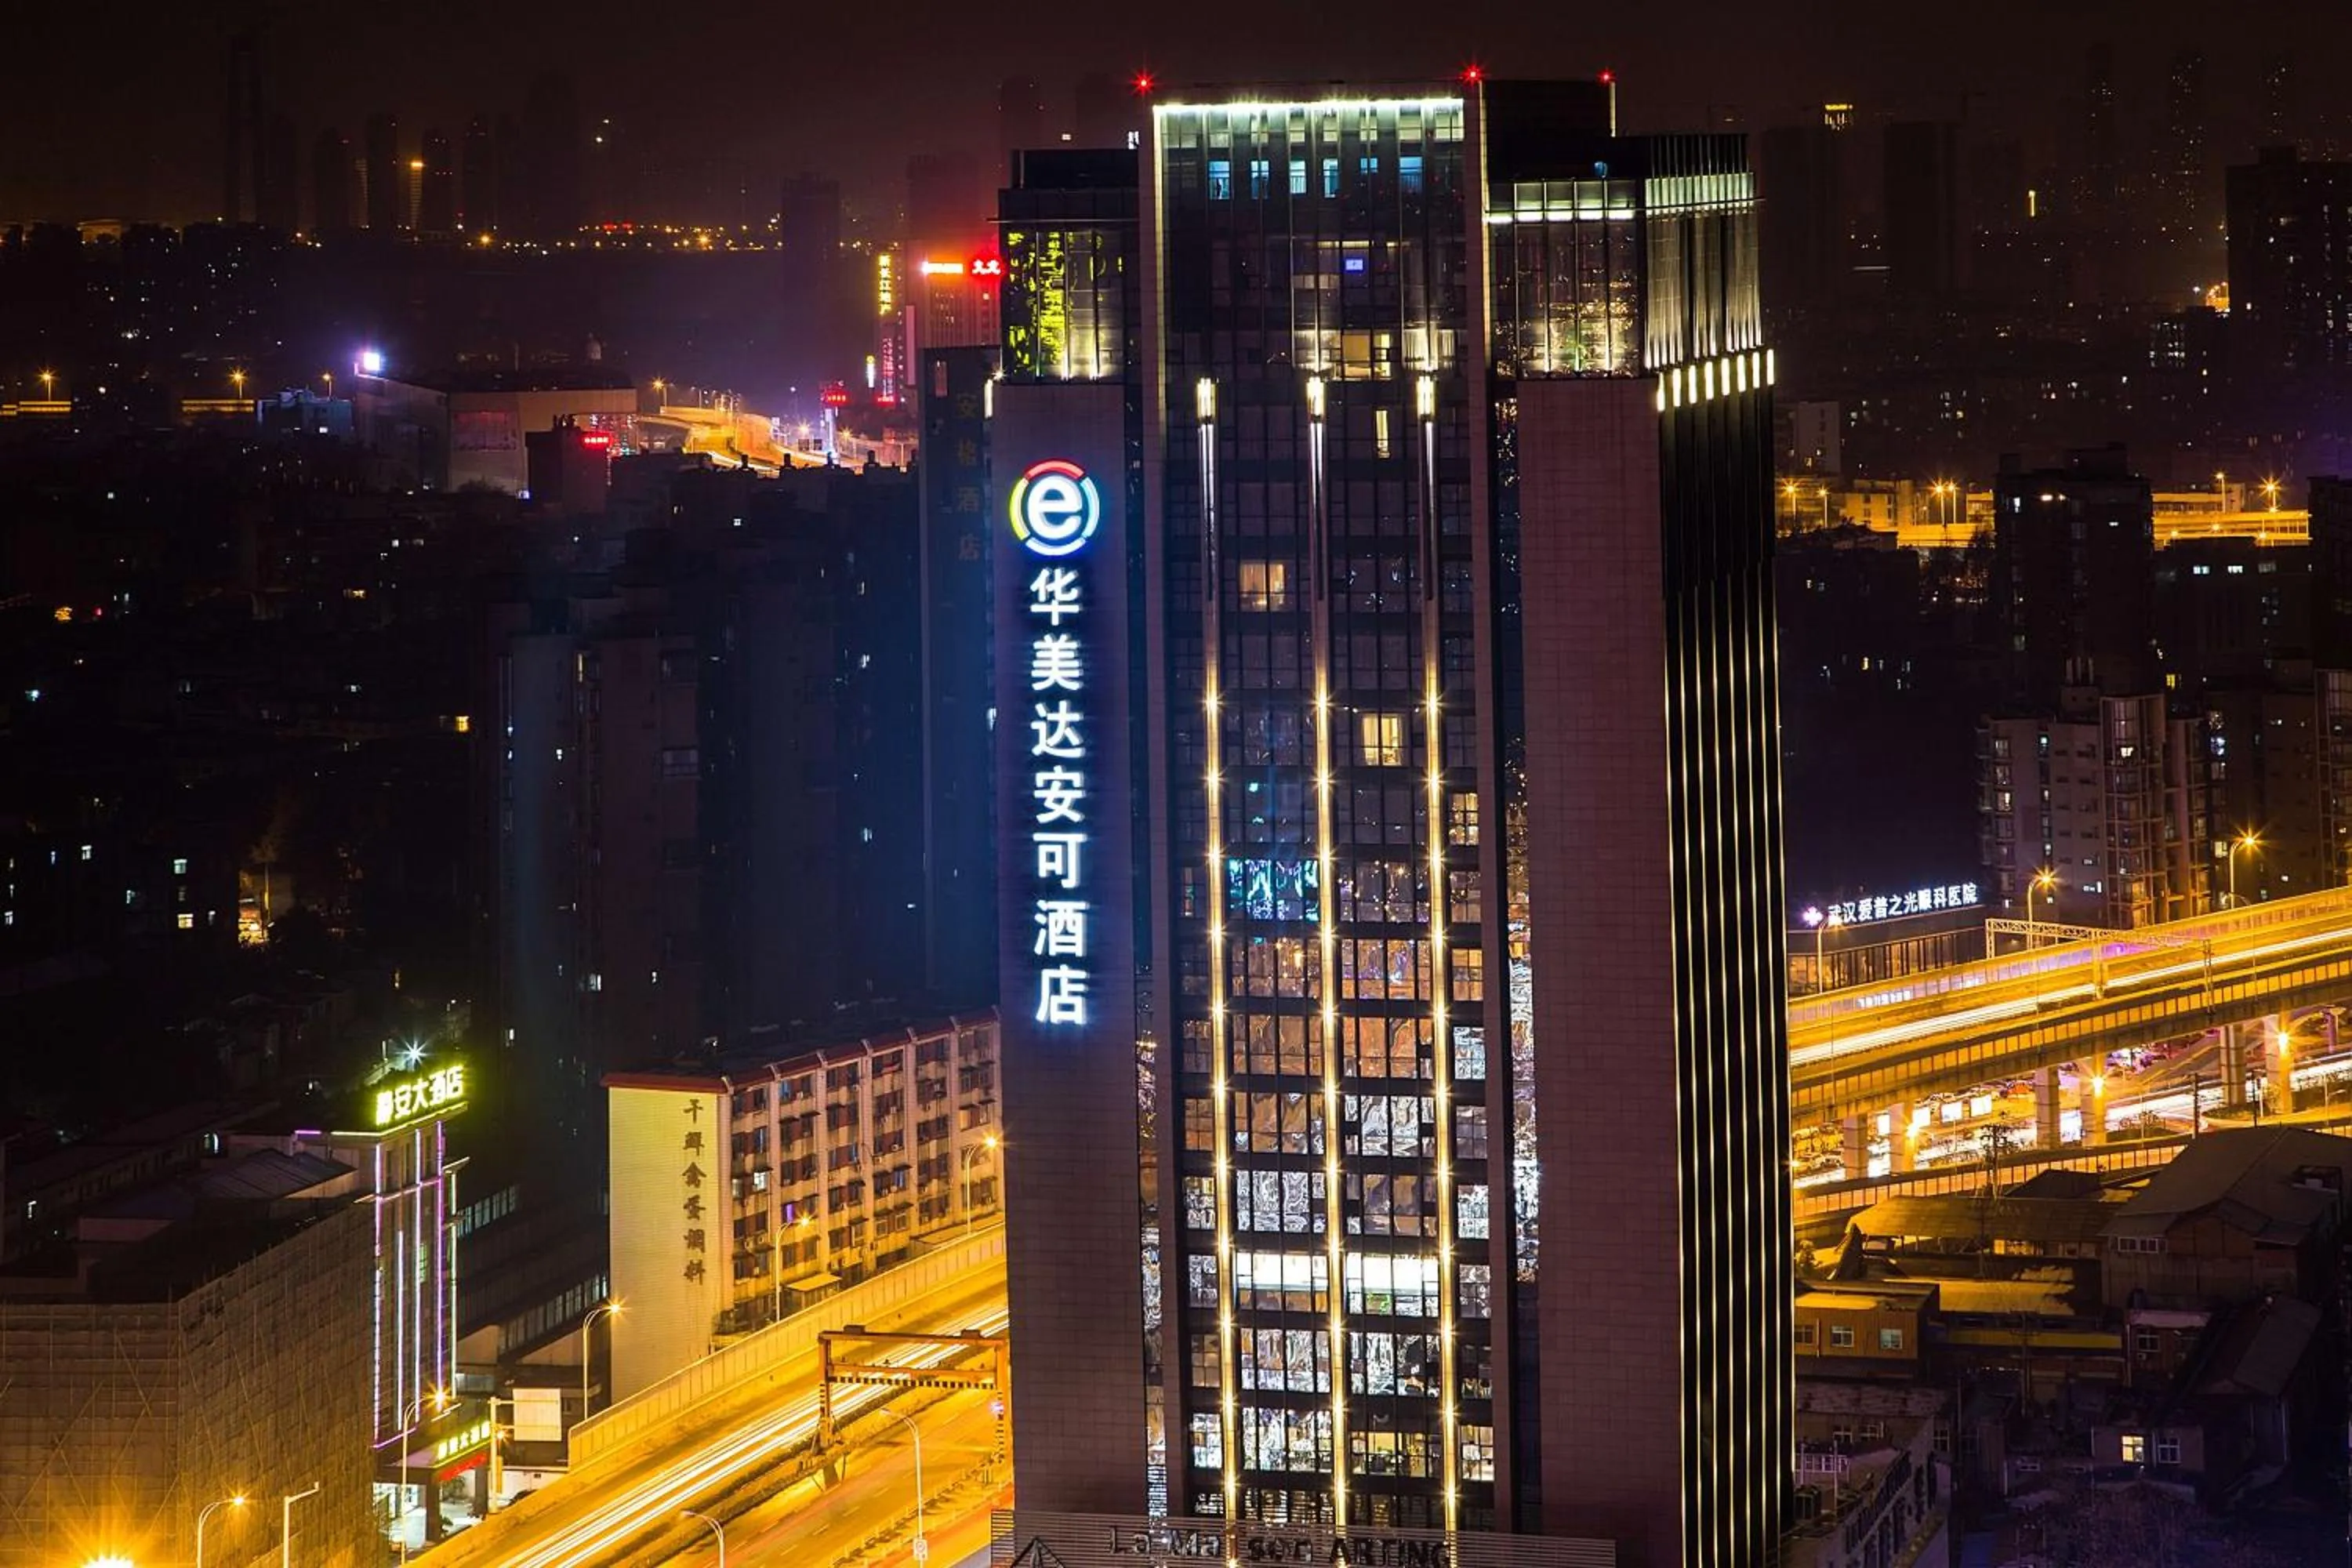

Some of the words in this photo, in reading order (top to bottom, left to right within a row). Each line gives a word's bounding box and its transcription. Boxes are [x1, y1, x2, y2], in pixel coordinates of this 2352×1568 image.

[1029, 567, 1089, 1025] 华美达安可酒店
[1109, 1526, 1151, 1555] La
